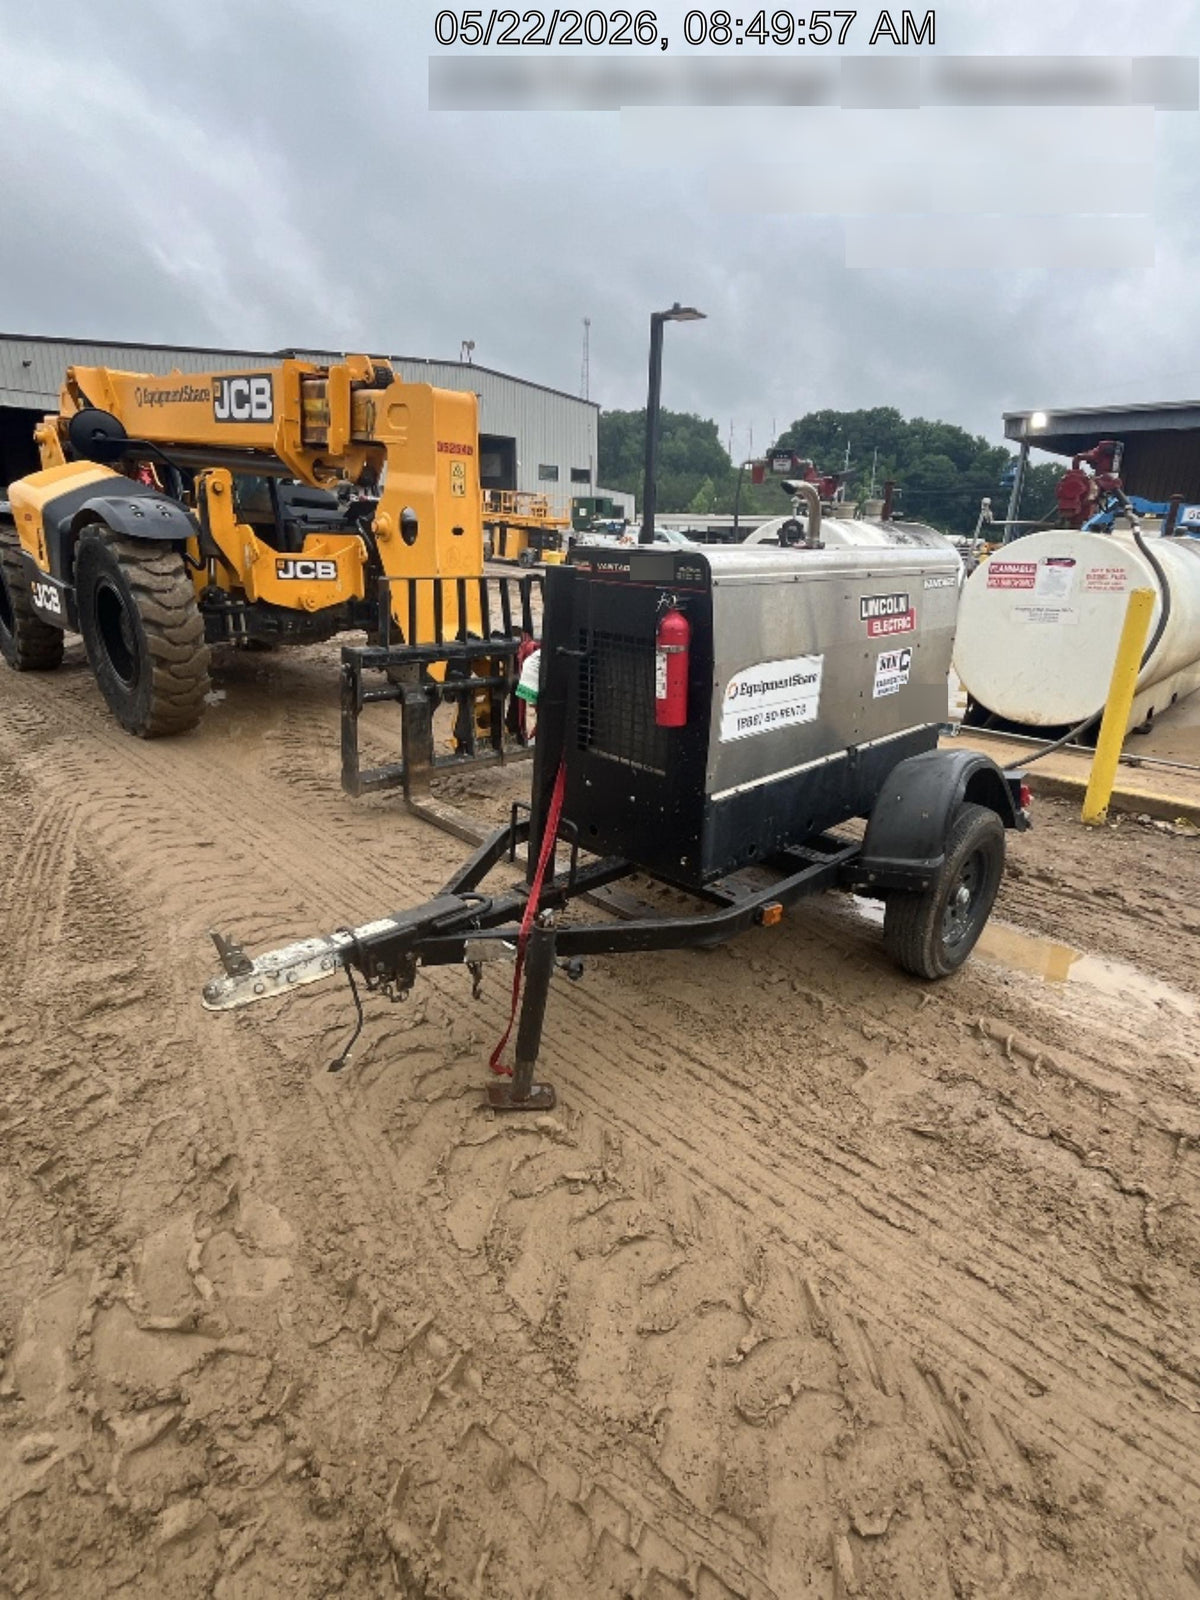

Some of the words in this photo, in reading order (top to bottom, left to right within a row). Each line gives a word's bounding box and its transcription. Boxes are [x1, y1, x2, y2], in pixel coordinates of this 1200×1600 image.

[214, 378, 272, 419] JCB
[277, 561, 337, 579] JCB
[33, 582, 61, 614] JCB
[861, 597, 906, 618] LINCOLN
[872, 617, 911, 634] ELECTRIC
